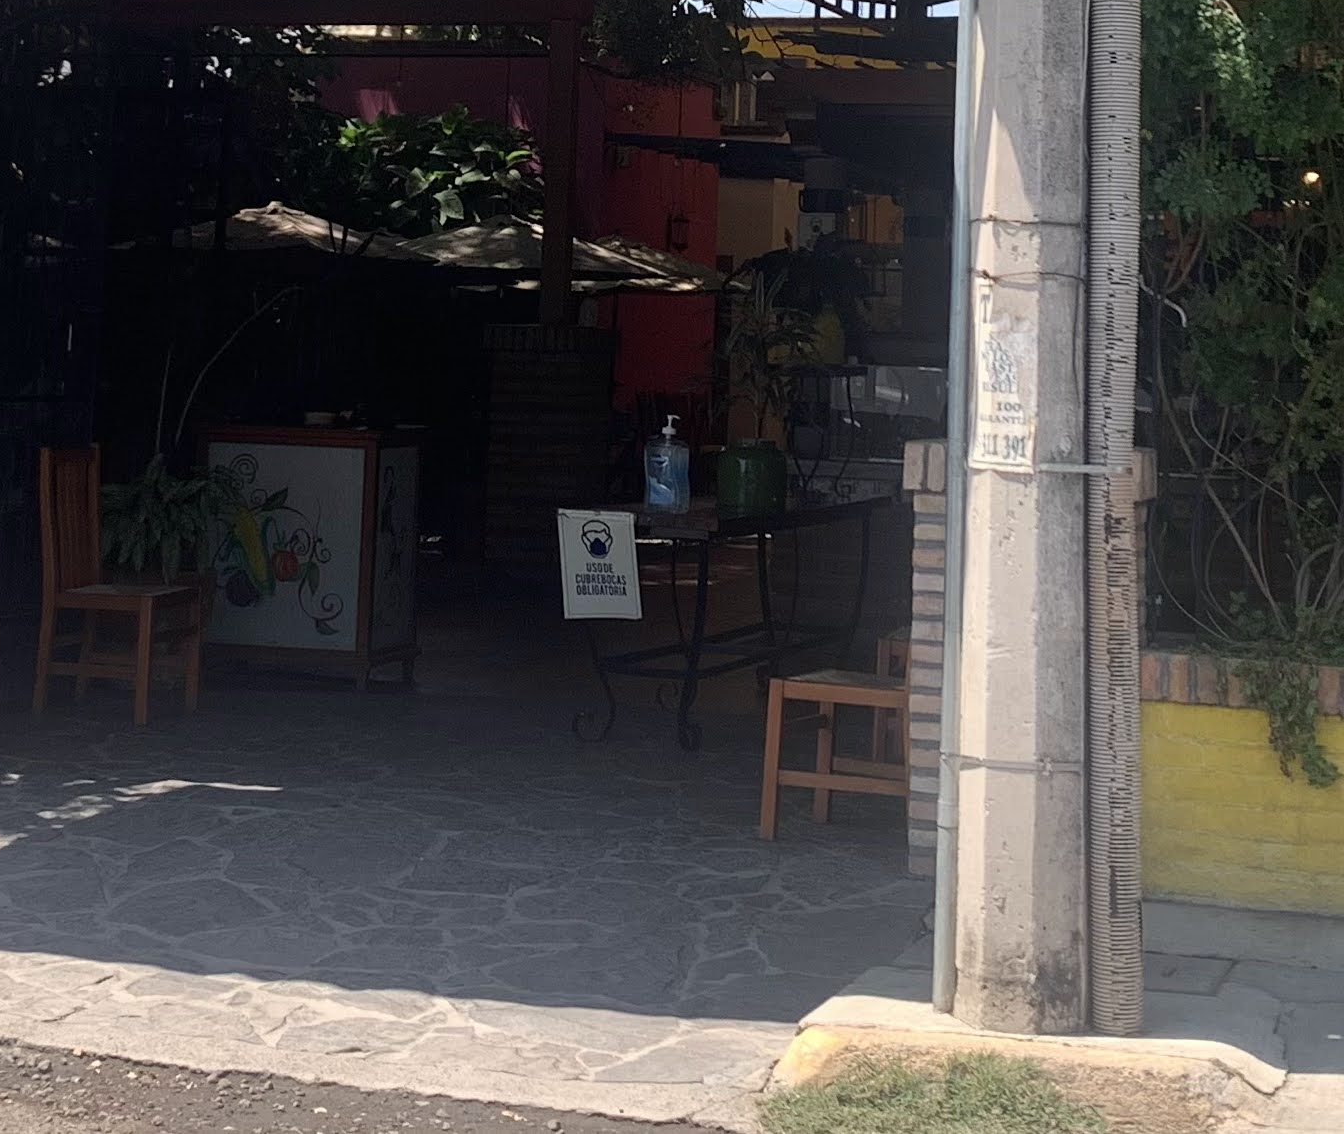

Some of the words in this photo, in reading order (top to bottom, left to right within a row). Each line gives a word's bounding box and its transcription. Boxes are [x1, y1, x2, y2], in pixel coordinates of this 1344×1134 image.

[586, 562, 603, 572] USO
[603, 563, 614, 574] DE
[575, 573, 627, 585] CUBREBOCAS
[576, 585, 628, 596] OBLIGATORIA
